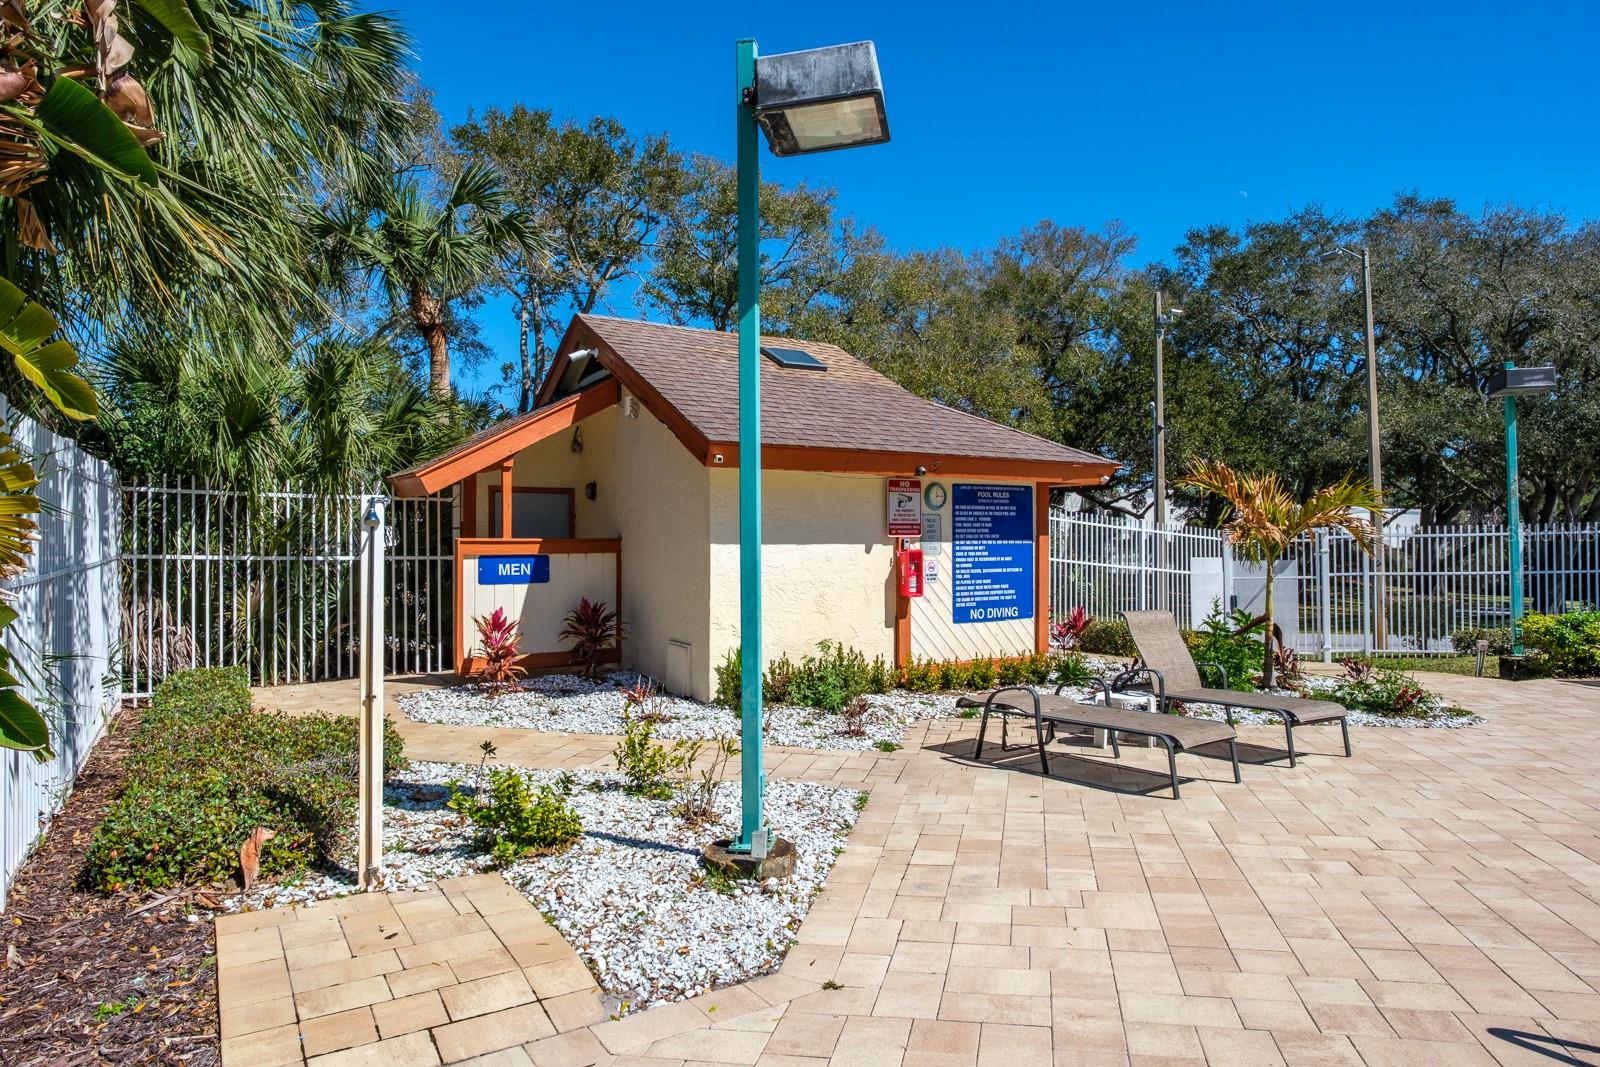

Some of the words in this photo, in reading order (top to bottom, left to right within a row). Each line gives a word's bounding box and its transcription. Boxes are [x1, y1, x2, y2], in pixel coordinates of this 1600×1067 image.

[498, 563, 531, 576] MEN
[970, 608, 985, 620] NO
[987, 606, 1018, 619] DIVING
